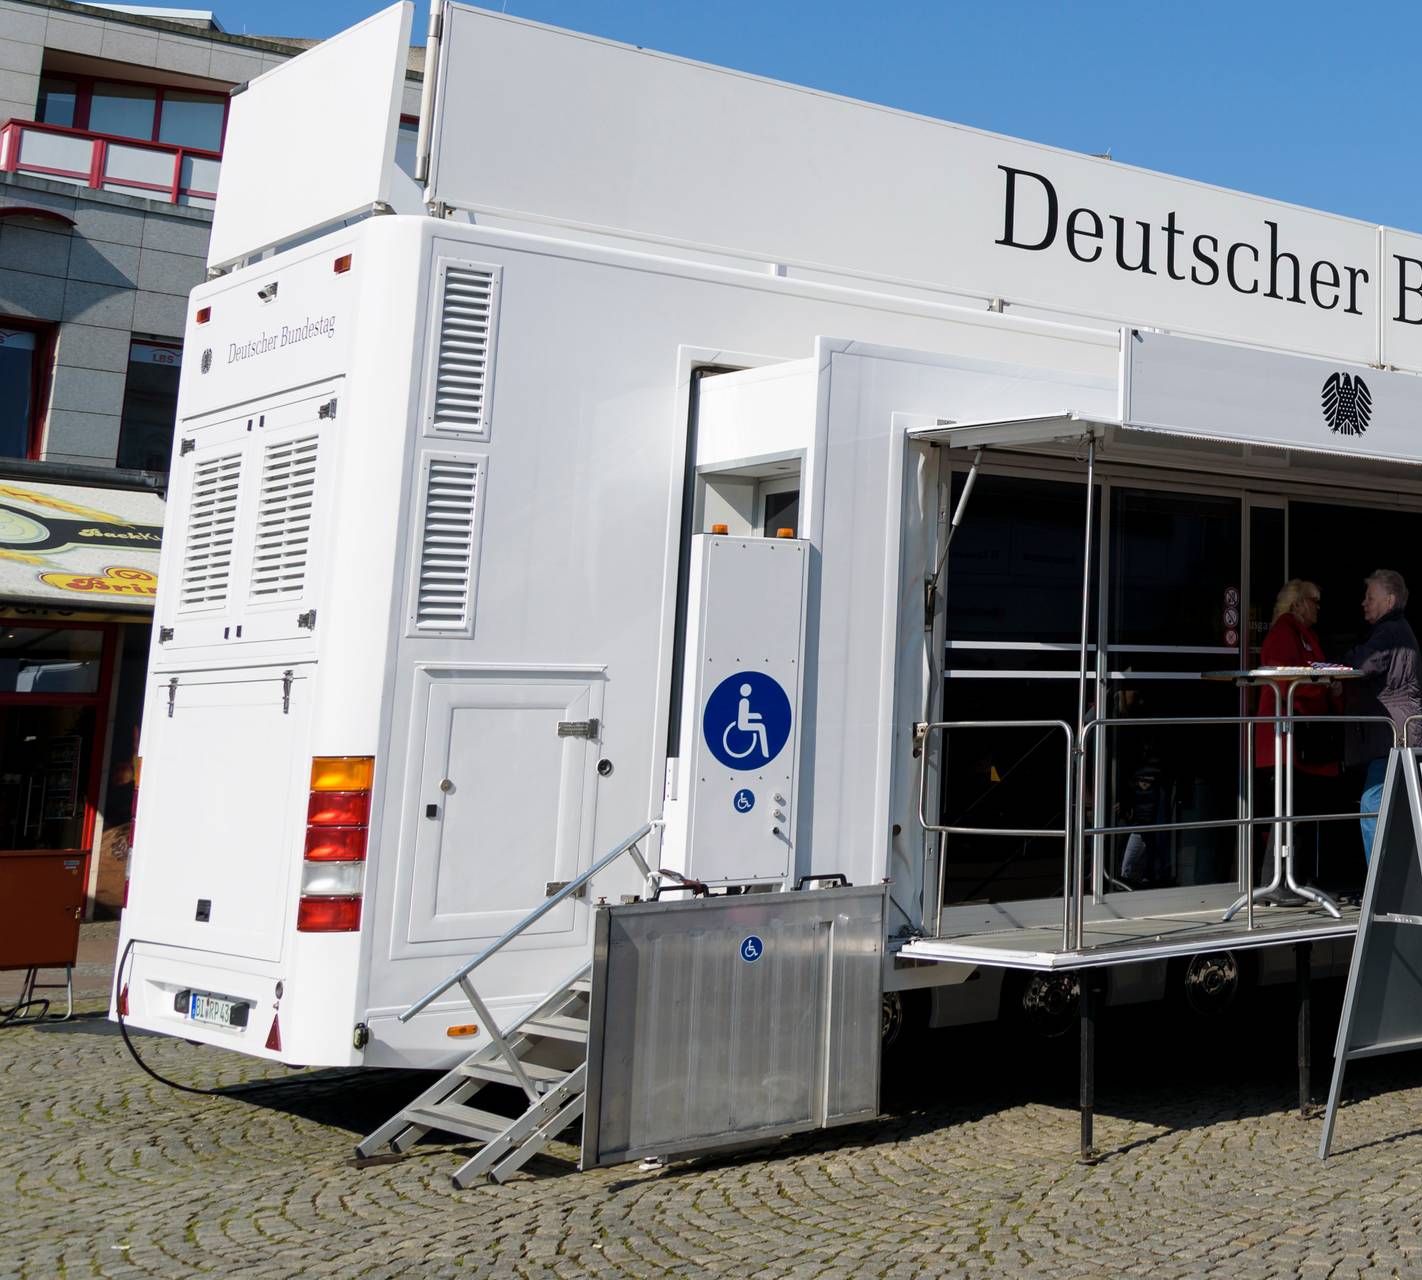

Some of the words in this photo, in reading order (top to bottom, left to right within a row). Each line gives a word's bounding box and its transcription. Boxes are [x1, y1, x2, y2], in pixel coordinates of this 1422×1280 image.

[995, 165, 1369, 315] Deutscher
[152, 354, 174, 363] LBS
[228, 332, 278, 363] Deutscher
[280, 316, 336, 347] Bundestag
